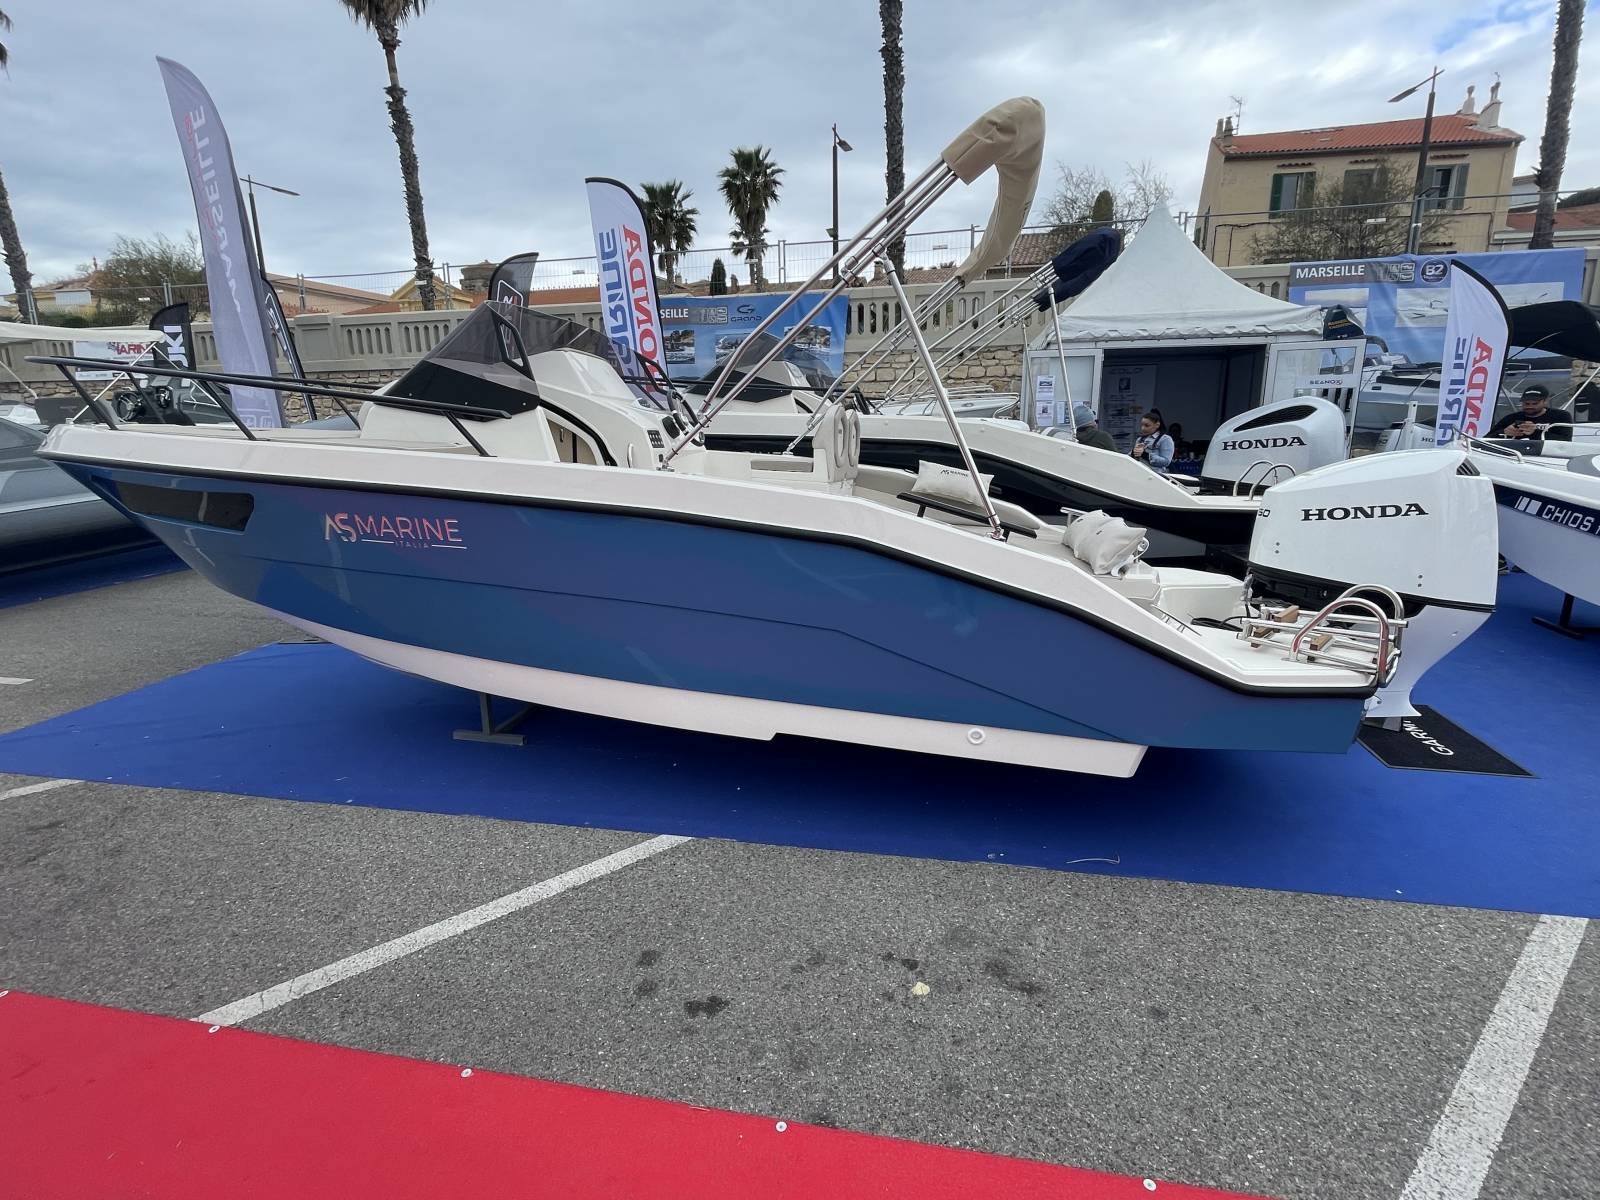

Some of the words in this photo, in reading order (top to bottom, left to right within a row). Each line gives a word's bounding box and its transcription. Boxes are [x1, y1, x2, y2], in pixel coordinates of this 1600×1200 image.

[1296, 264, 1365, 279] MARSEILLE
[1222, 436, 1307, 451] HONDA
[1301, 502, 1429, 521] HONDA
[1542, 504, 1595, 532] CHIOS
[354, 514, 463, 543] MARINE
